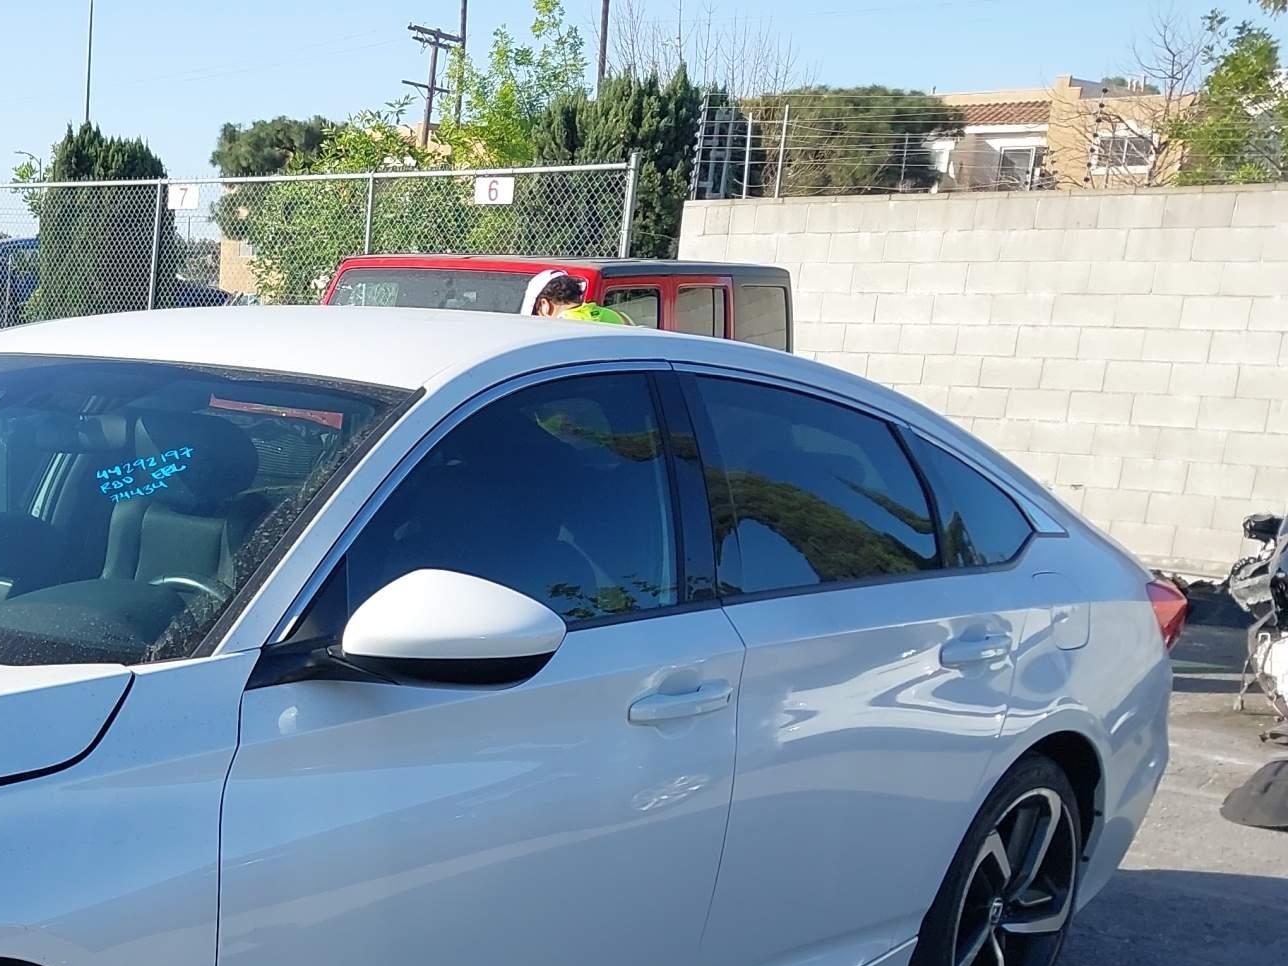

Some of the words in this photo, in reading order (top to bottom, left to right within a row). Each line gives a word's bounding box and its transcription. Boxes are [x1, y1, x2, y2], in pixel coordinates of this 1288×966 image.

[179, 187, 189, 207] 7
[488, 179, 500, 202] 6
[96, 446, 193, 478] 44292197
